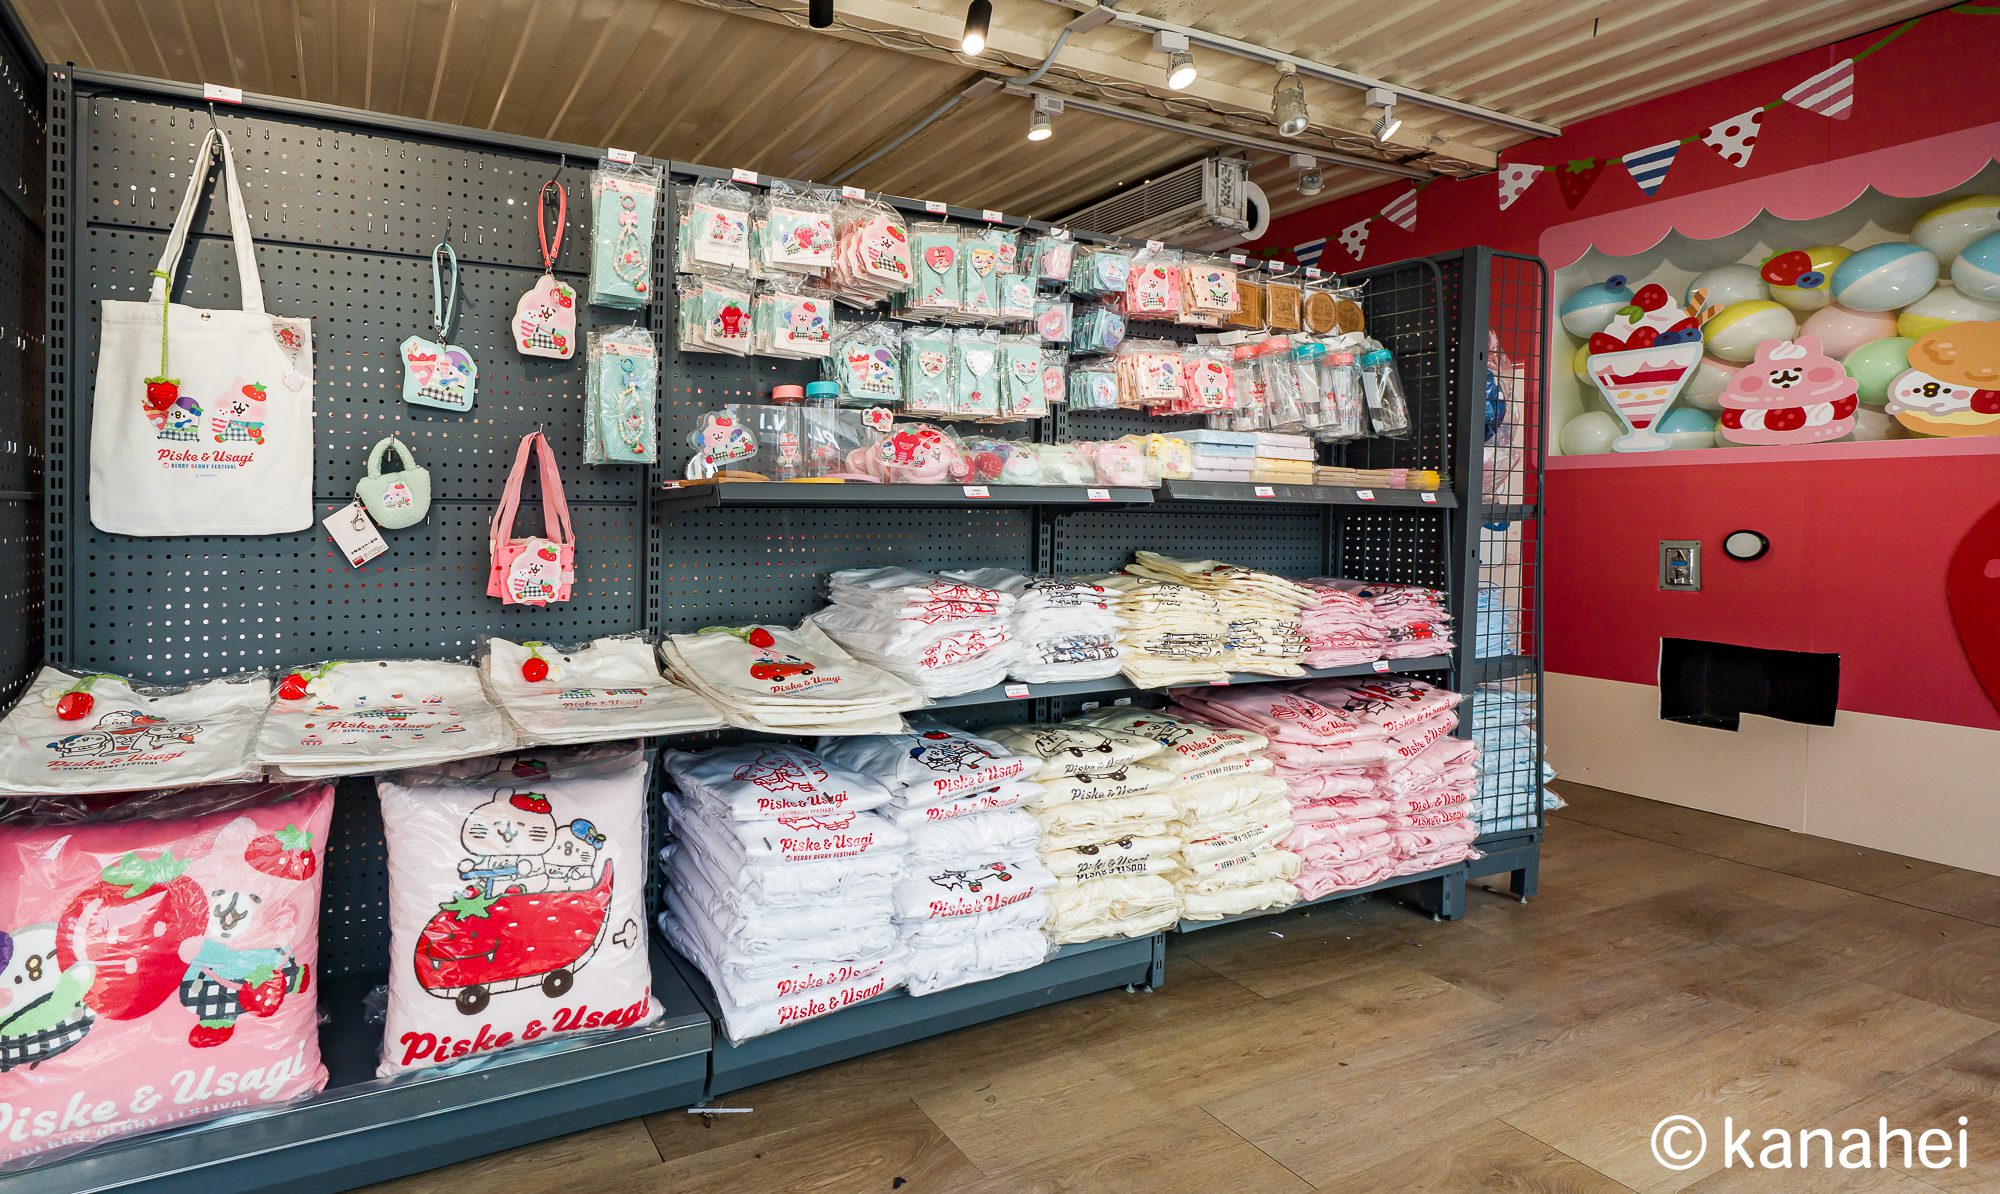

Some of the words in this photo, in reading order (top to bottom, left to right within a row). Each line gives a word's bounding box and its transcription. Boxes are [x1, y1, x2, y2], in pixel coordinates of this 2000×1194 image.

[157, 449, 198, 461] Piske
[201, 453, 211, 462] &
[212, 450, 254, 466] Usagi
[770, 683, 803, 693] Piske
[326, 720, 376, 730] Piske
[1176, 741, 1209, 755] Piske
[1207, 737, 1217, 745] &
[46, 759, 105, 768] Piske
[127, 750, 186, 762] Usagi
[934, 774, 975, 795] Piske
[985, 760, 1024, 780] Usagi
[1071, 787, 1105, 801] Piske
[757, 798, 798, 812] Piske
[799, 800, 807, 808] &
[780, 837, 822, 853] Piske
[824, 839, 833, 850] &
[833, 833, 874, 852] Usagi
[929, 897, 973, 919] Piske
[777, 973, 824, 997] Piske
[827, 972, 837, 985] &
[838, 960, 883, 982] Usi
[777, 999, 826, 1025] Piske
[829, 996, 839, 1010] &
[840, 977, 885, 1006] Usagi
[400, 1023, 515, 1066] Piske
[521, 1020, 548, 1041] &
[552, 986, 651, 1032] Usagi
[129, 1085, 163, 1115] &
[170, 1040, 308, 1106] Usagi
